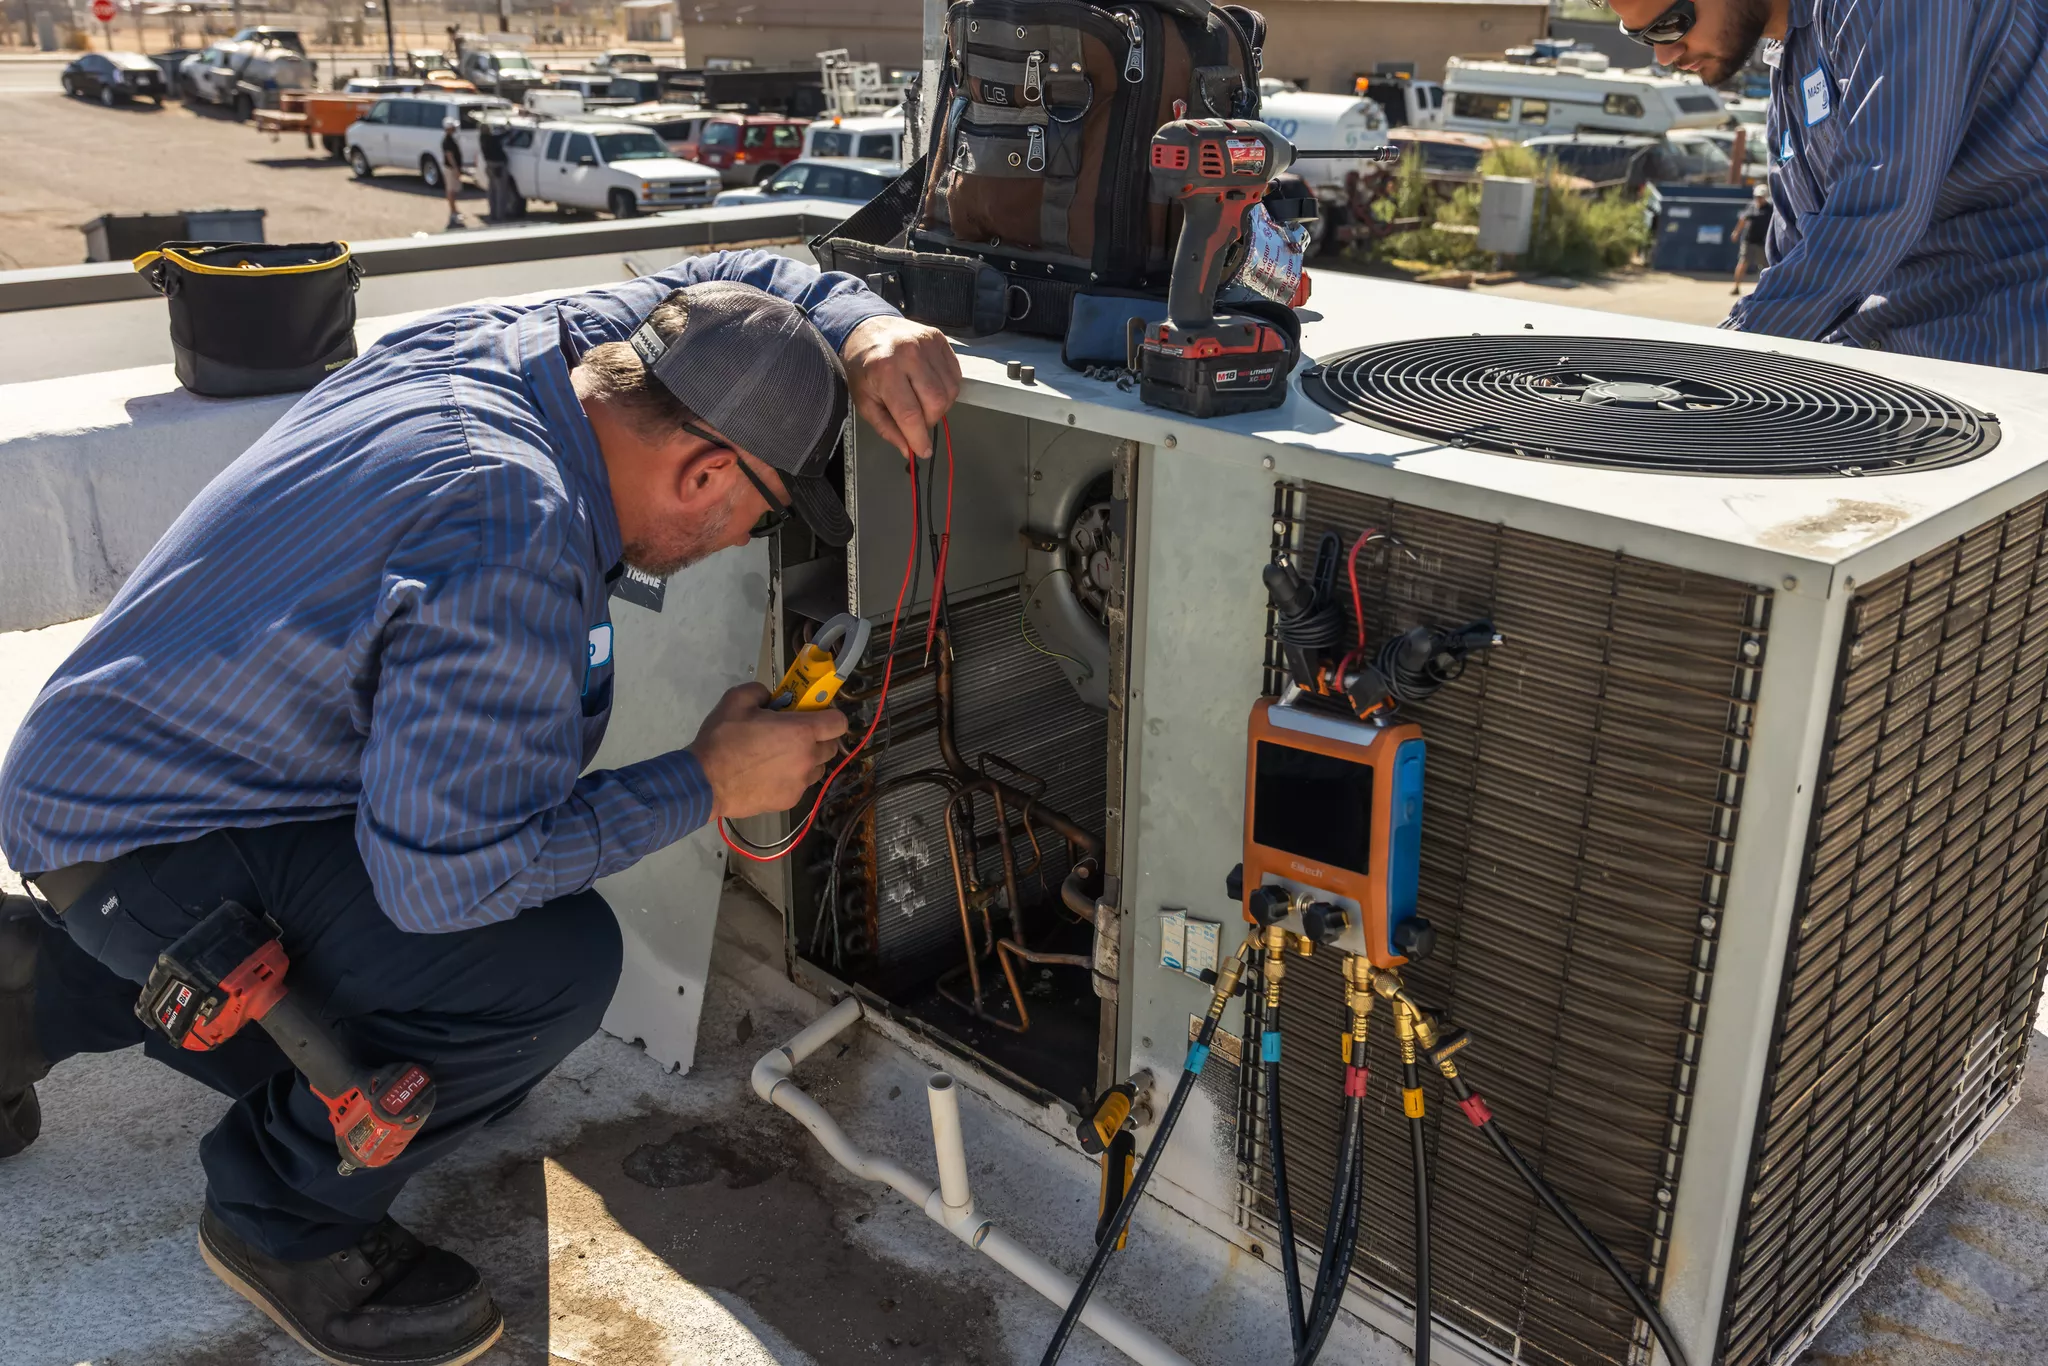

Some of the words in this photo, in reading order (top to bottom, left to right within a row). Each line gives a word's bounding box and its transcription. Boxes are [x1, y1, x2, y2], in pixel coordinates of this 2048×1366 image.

[984, 84, 1008, 105] LC
[1265, 258, 1274, 276] 1402
[1288, 273, 1297, 289] 1402
[1217, 371, 1236, 381] M18
[1291, 861, 1324, 878] Elitech
[179, 988, 191, 1005] M18
[392, 1075, 425, 1105] FUEL
